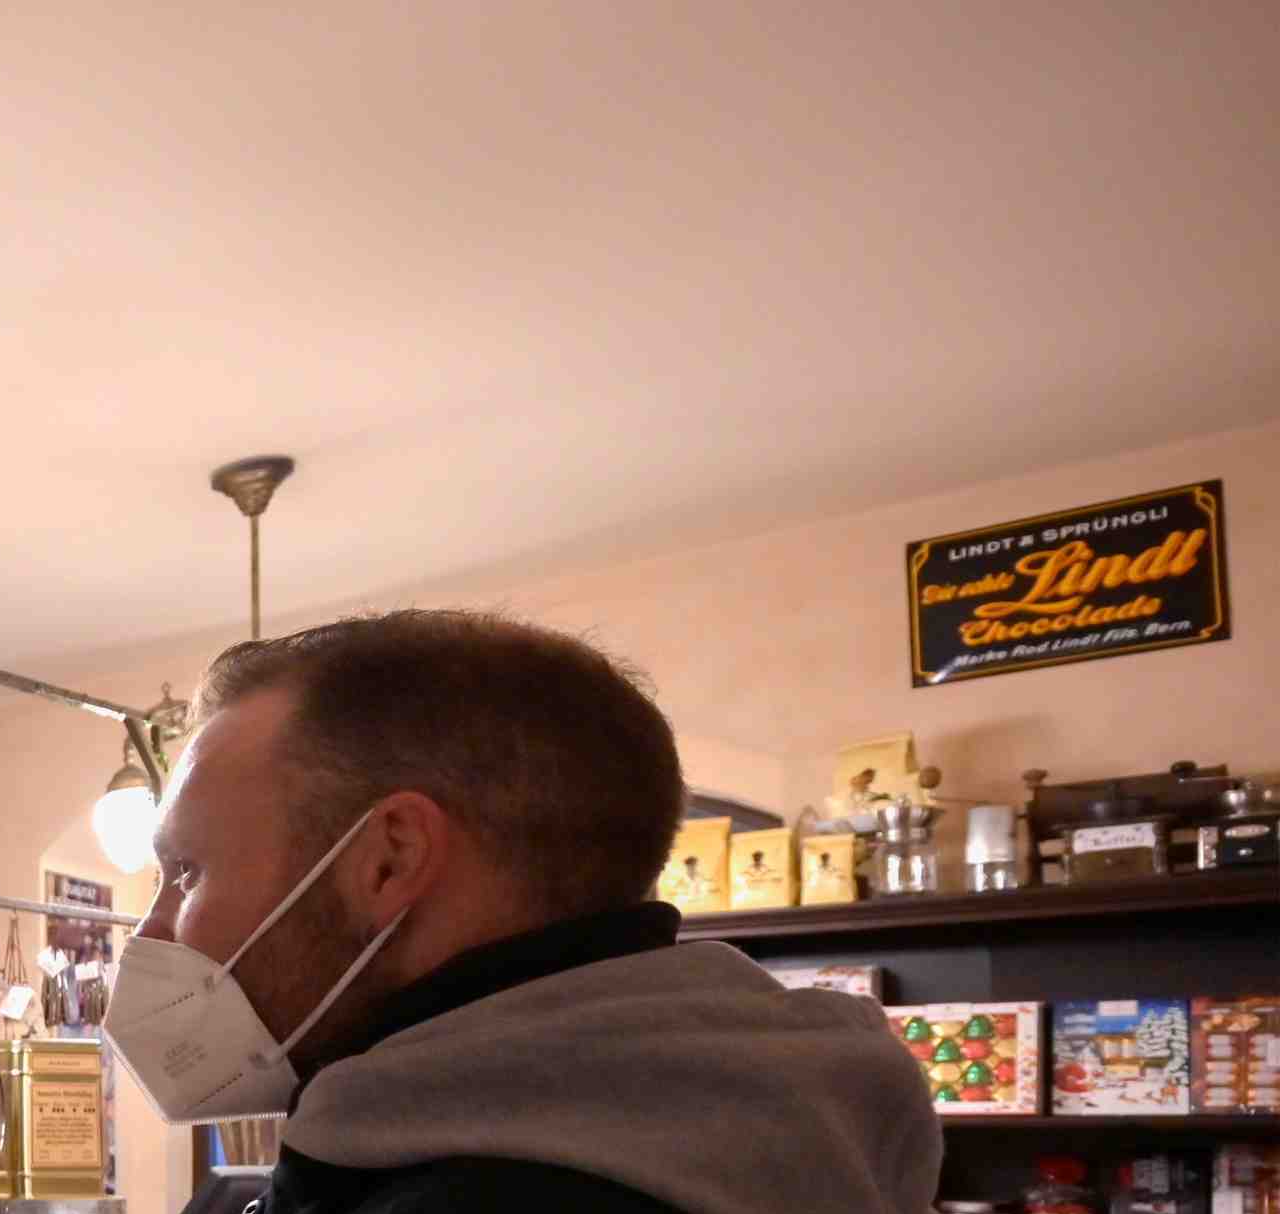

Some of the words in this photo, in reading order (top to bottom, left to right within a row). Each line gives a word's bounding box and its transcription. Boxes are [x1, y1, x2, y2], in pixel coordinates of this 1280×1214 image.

[948, 535, 1013, 561] LINDT
[1017, 534, 1036, 549] &
[1040, 505, 1170, 545] SPRÜNGLI
[973, 527, 1207, 619] Lindt
[958, 595, 1162, 647] Chocolade
